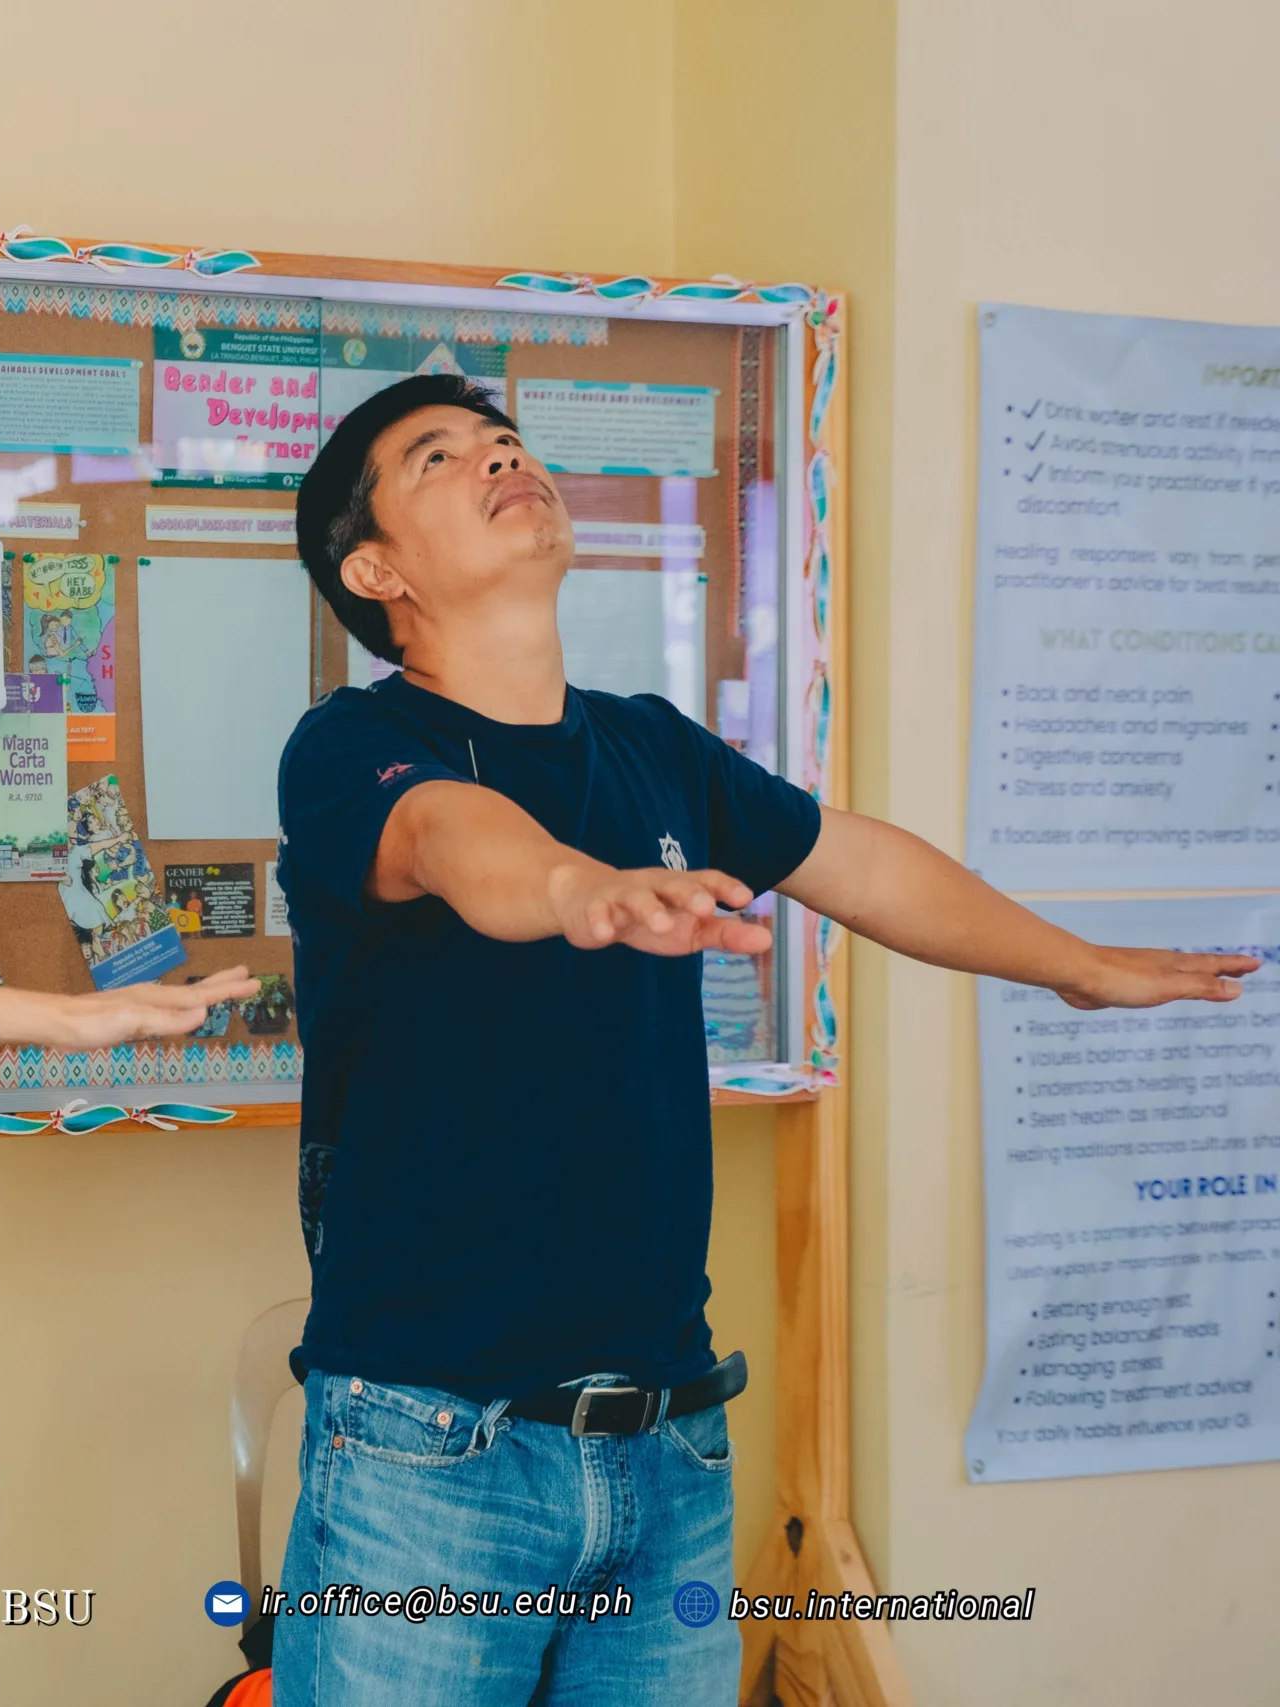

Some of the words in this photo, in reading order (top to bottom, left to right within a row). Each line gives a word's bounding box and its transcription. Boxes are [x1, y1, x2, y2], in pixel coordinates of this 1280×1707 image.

[220, 342, 256, 352] BENGUET
[257, 343, 281, 353] STATE
[38, 366, 98, 377] DEVELOPMENT
[164, 366, 256, 394] Gender
[270, 372, 318, 399] and
[9, 515, 73, 530] MATERIALS
[151, 517, 253, 532] ACCOMPLISHMENT
[67, 576, 87, 587] HEY
[70, 586, 92, 597] BABE
[1039, 627, 1102, 650] WHAT
[1108, 628, 1246, 653] CONDITIONS
[101, 645, 112, 661] S
[101, 664, 114, 680] H
[1063, 684, 1100, 702] and
[1151, 684, 1193, 709] pain
[1014, 716, 1118, 734] Headaches
[1122, 717, 1159, 735] and
[1162, 717, 1249, 740] migraines
[3, 735, 49, 754] Magna
[10, 752, 46, 768] Carta
[1013, 746, 1095, 771] Digestive
[0, 769, 53, 785] Women
[8, 793, 22, 802] R.A.
[24, 793, 42, 802] 9710
[1013, 778, 1067, 797] Stress
[1070, 778, 1106, 796] and
[1110, 780, 1174, 801] anxiety
[1005, 825, 1072, 844] focuses
[1103, 825, 1191, 850] improving
[166, 868, 204, 877] GENDER
[170, 878, 204, 888] EQUITY
[1133, 1176, 1194, 1201] YOUR
[1197, 1173, 1248, 1198] ROLE
[1254, 1172, 1278, 1195] IN
